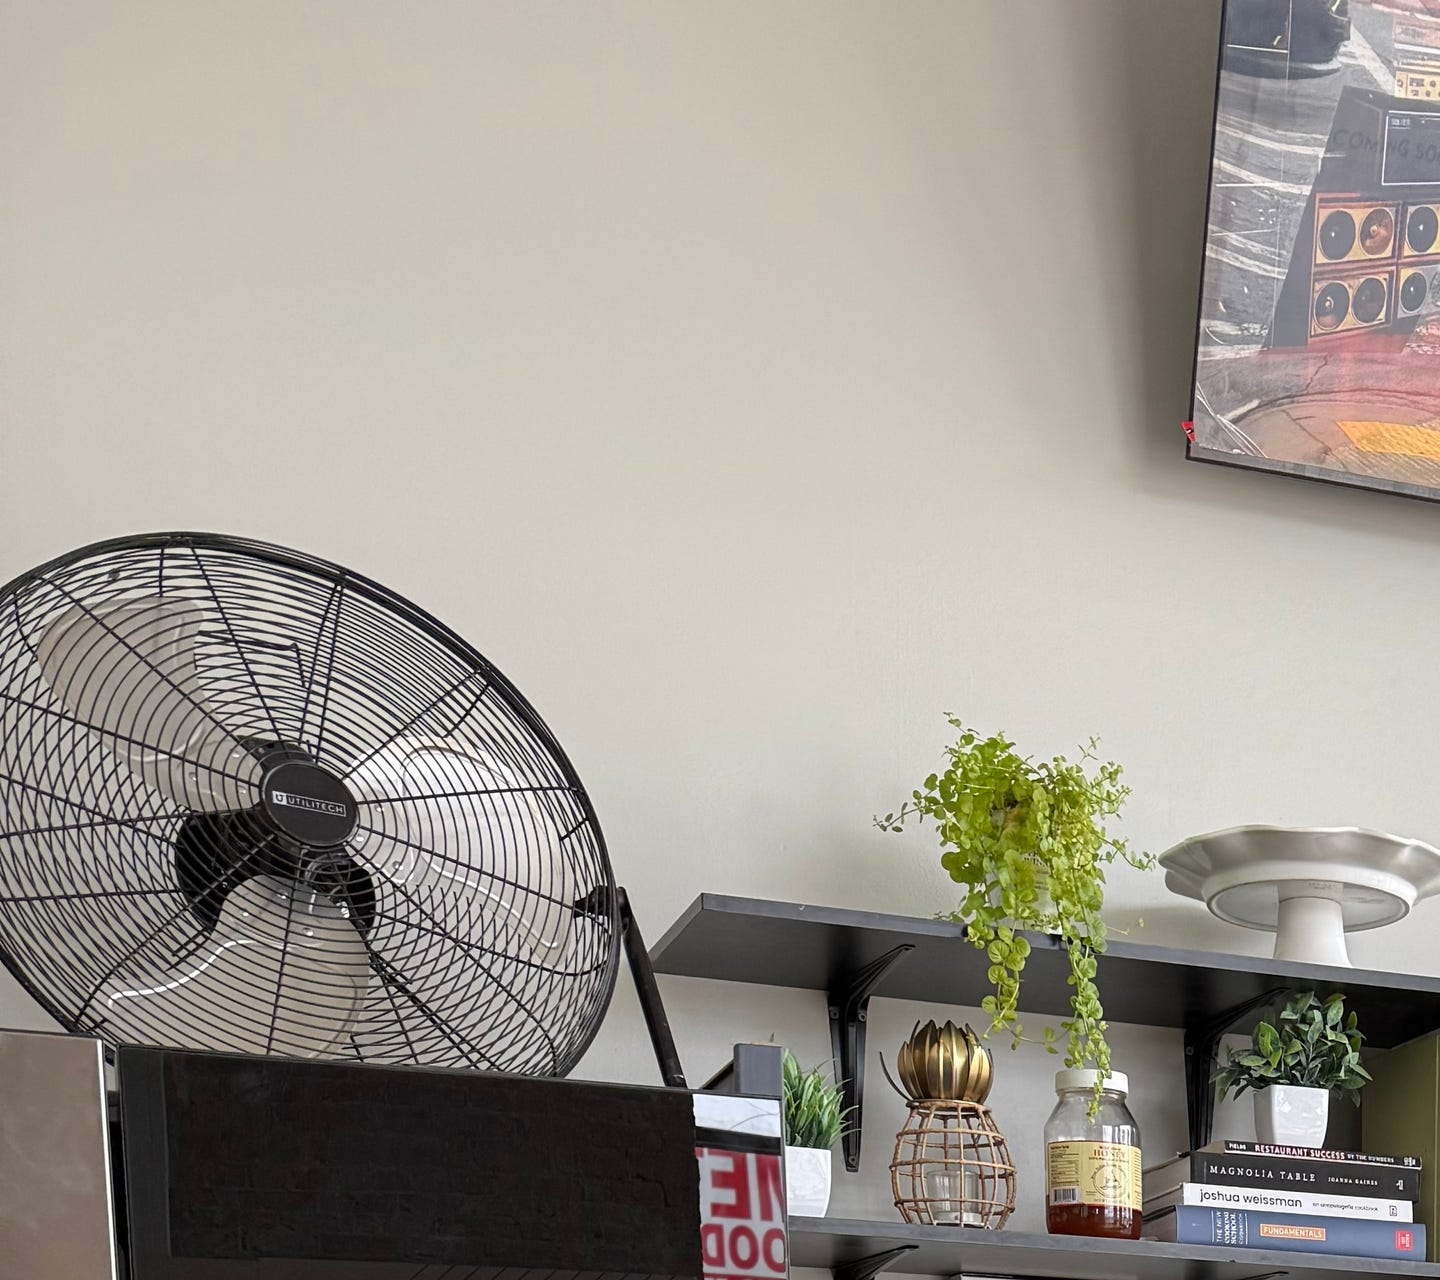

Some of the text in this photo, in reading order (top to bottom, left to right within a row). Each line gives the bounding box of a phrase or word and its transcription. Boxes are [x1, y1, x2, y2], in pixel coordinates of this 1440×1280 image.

[1332, 128, 1410, 158] COMNG
[288, 796, 343, 813] UTILITECH
[1255, 1144, 1309, 1158] RESTAURANT
[1310, 1150, 1345, 1160] SUCCESS
[1210, 1165, 1274, 1180] MAGNOLIA
[1280, 1170, 1316, 1183] TABLE
[1327, 1176, 1353, 1185] JOANNA
[1200, 1188, 1240, 1203] joshua
[1242, 1194, 1303, 1208] weissman
[1264, 1226, 1323, 1239] FUNDAMENTALS
